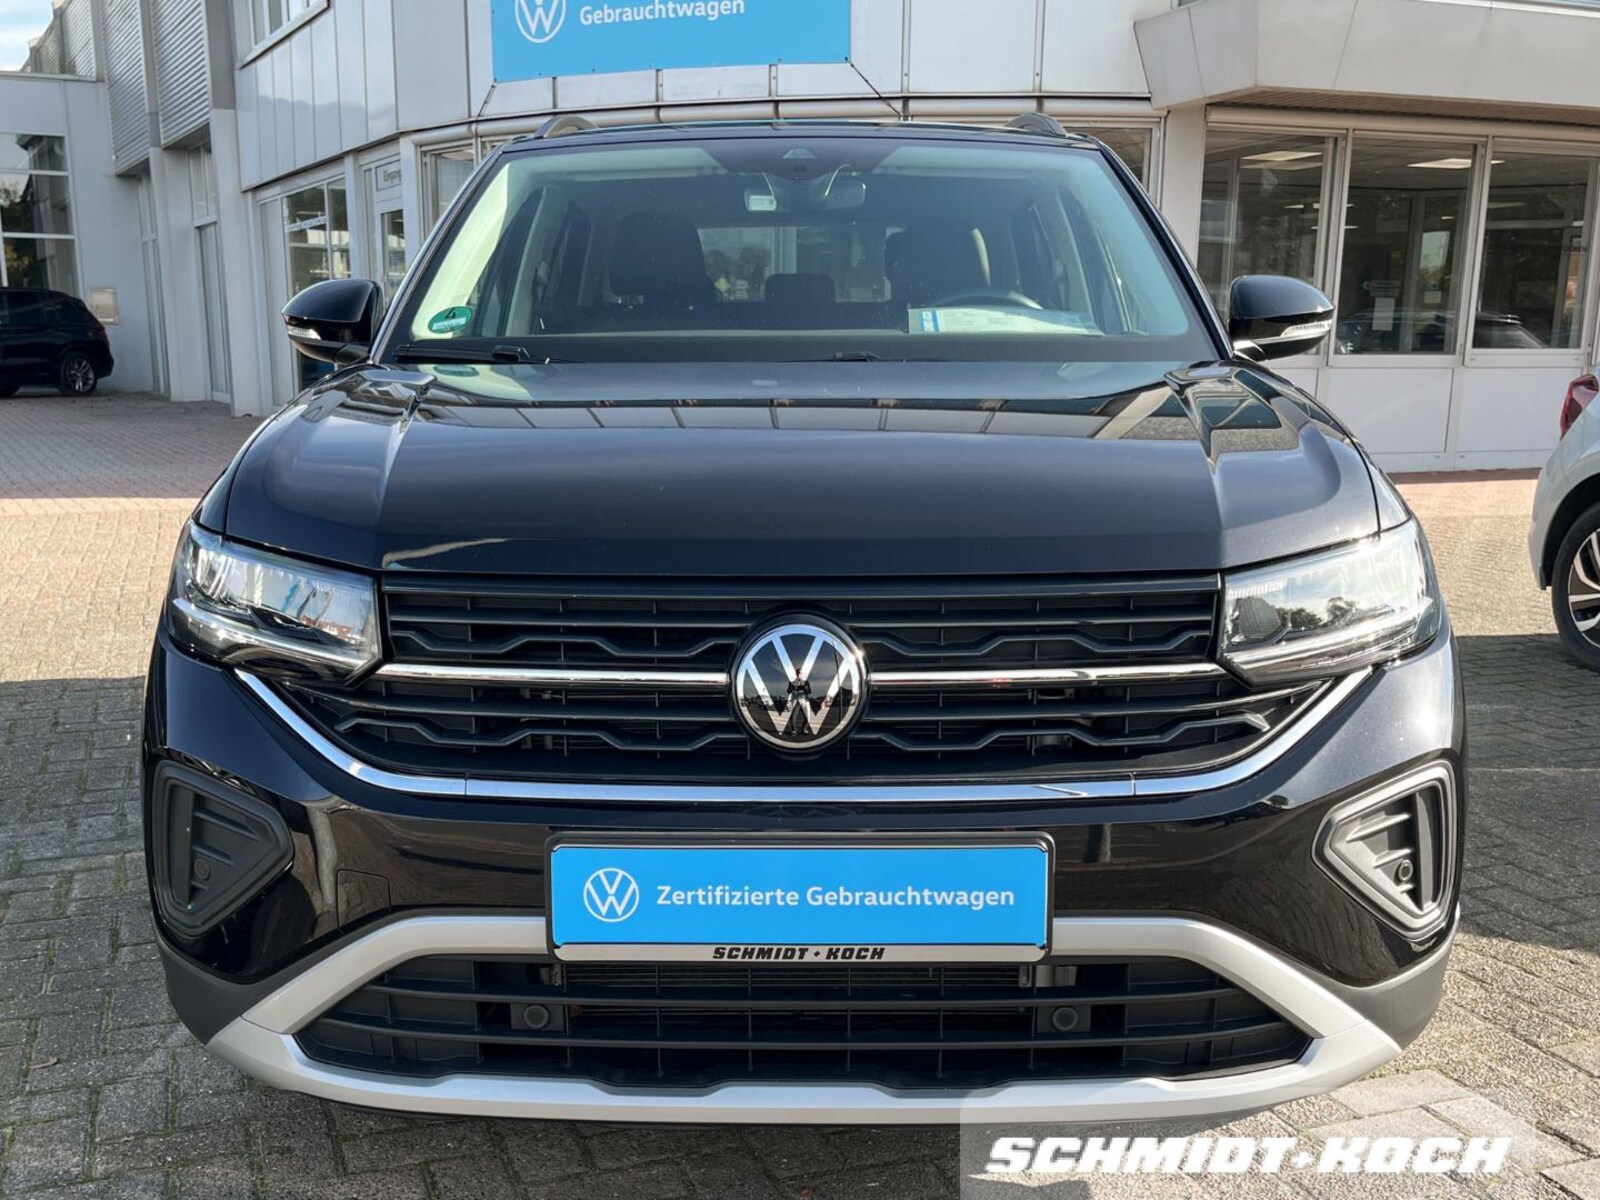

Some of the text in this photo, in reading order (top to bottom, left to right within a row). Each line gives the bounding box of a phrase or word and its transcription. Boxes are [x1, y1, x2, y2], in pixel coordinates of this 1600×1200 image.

[579, 0, 745, 25] Gebrauchtwagen
[656, 885, 1015, 911] Zertifizierte Gebrauchtwagen
[712, 946, 809, 960] SCHMIDT
[825, 946, 886, 960] KOCH
